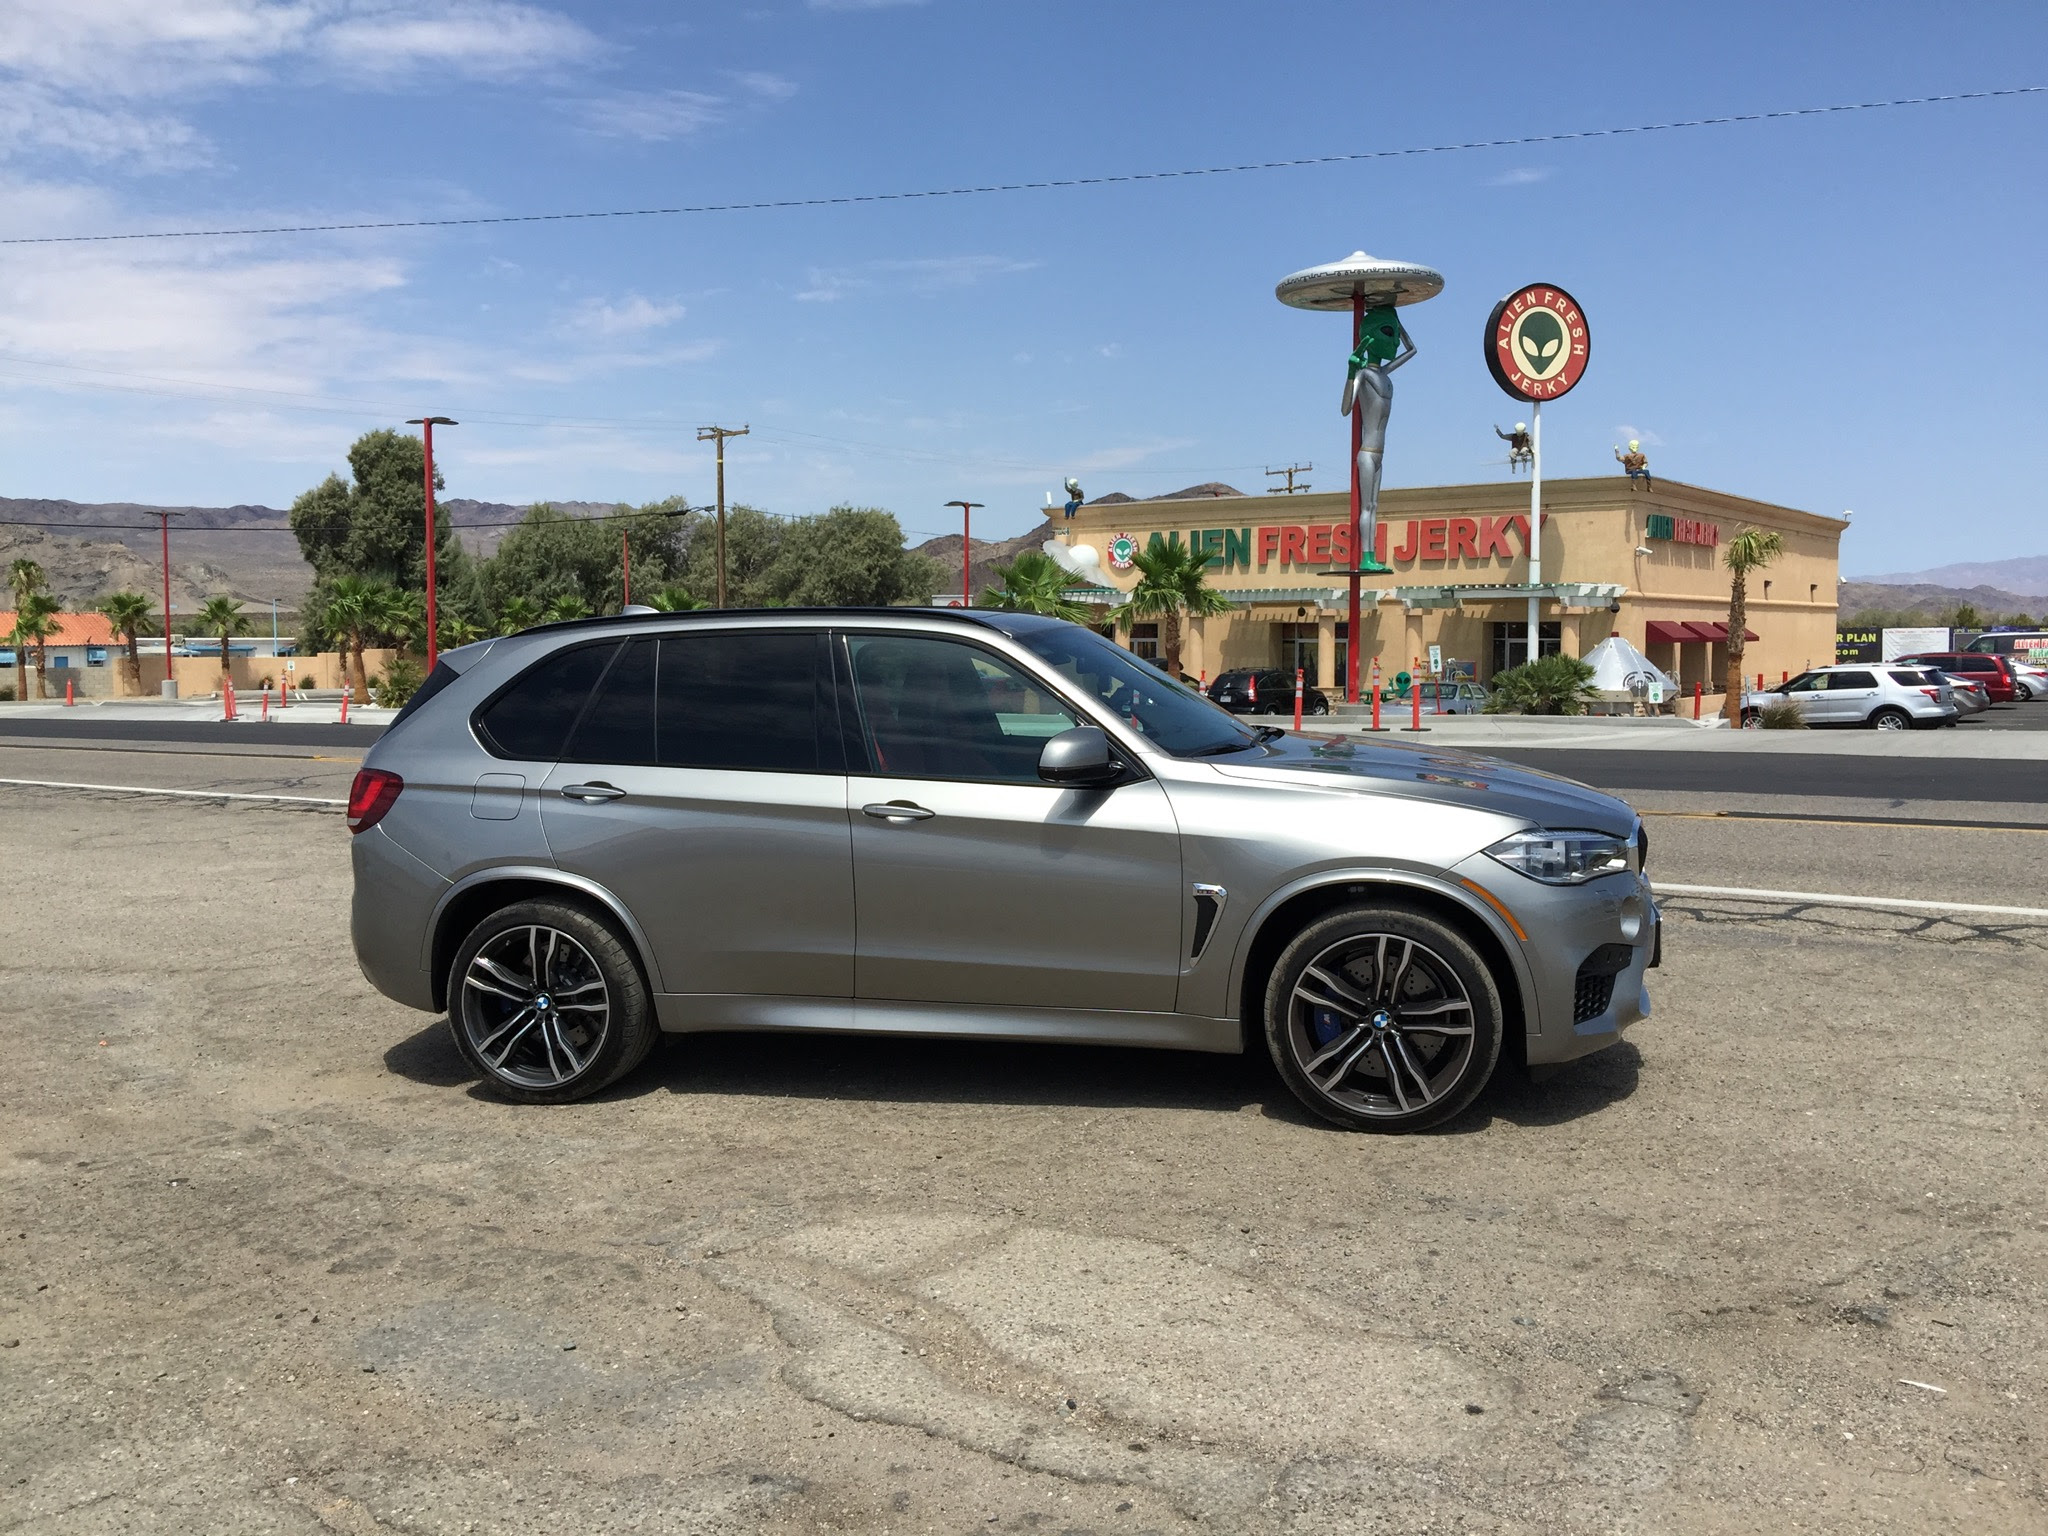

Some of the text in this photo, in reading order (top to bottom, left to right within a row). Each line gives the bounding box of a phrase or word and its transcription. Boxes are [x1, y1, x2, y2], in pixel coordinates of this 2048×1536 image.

[1498, 291, 1585, 356] ALIEN FRESH
[1511, 372, 1568, 395] JERKY
[1846, 633, 1877, 643] PLAN
